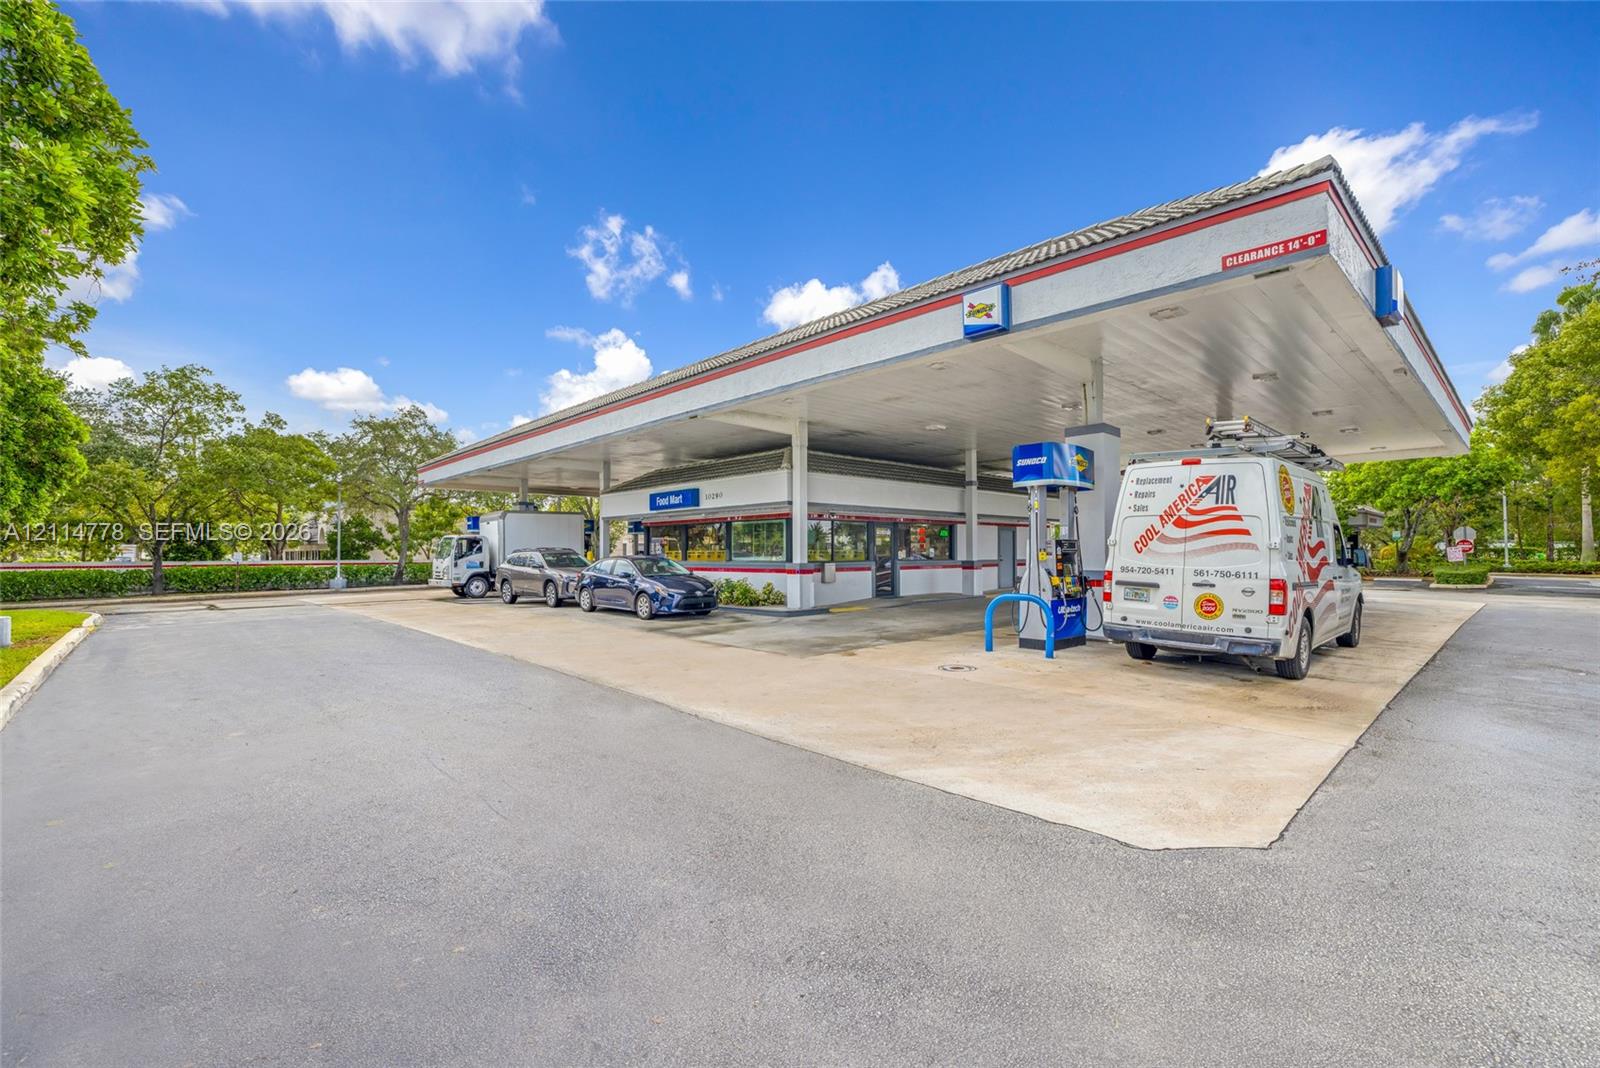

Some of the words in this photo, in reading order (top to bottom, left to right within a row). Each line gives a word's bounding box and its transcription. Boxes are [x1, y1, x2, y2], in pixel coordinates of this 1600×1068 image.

[1226, 243, 1285, 267] CLEARANCE
[1016, 456, 1048, 467] SUNOCO
[1135, 476, 1173, 486] Replacement
[1134, 490, 1156, 499] Repairs
[1197, 474, 1237, 505] AIR
[656, 496, 669, 507] Food
[670, 494, 683, 504] Mart
[1132, 504, 1149, 512] Sales
[1133, 524, 1161, 554] COOL
[1159, 478, 1206, 528] AMERICA
[1120, 565, 1175, 576] 954-720-5411
[1193, 569, 1259, 580] 561-750-6111
[1135, 618, 1234, 634] www.coolamericaair.com
